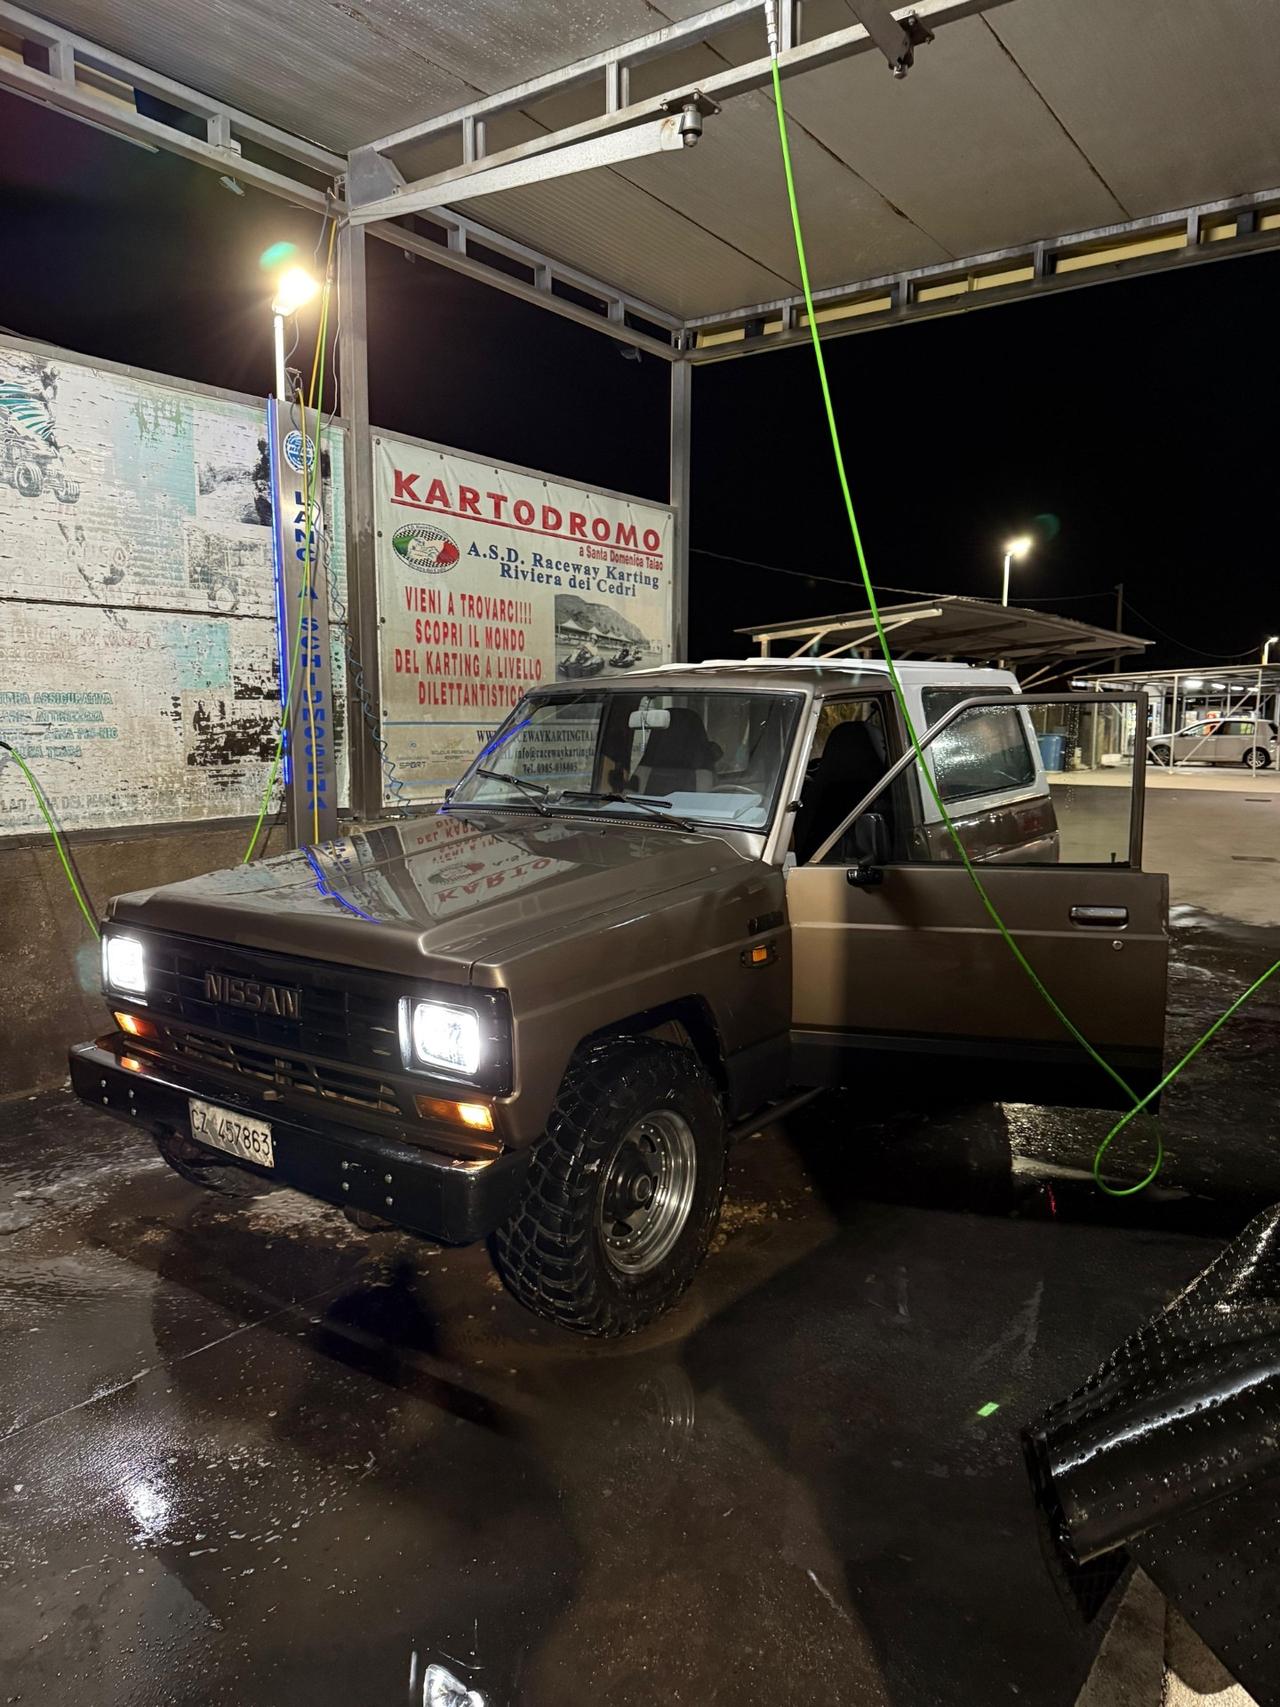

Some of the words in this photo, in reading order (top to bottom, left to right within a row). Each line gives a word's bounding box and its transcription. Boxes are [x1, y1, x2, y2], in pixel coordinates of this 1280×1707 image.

[393, 468, 661, 552] KARTODROMO
[467, 541, 525, 566] A.S.D.
[532, 552, 601, 580] Raceway
[605, 565, 660, 590] Karting
[578, 546, 585, 557] a
[586, 545, 608, 561] Santa
[610, 550, 644, 568] Domenica
[500, 562, 563, 586] Riviera
[568, 575, 591, 591] dei
[596, 578, 637, 597] Cedri
[405, 586, 442, 615] VIENI
[447, 592, 455, 616] A
[460, 593, 532, 625] TROVARCI!!!
[415, 618, 463, 647] SCOPRI
[469, 624, 480, 648] IL
[485, 626, 525, 652] MONDO
[395, 648, 419, 674] DEL
[426, 651, 480, 678] KARTING
[485, 655, 493, 678] A
[497, 656, 542, 681] LIVELLO
[418, 681, 525, 708] DILETTANTISTICO
[205, 974, 299, 1019] NISSAN
[191, 1109, 209, 1134] CZ
[218, 1118, 270, 1156] 457863
